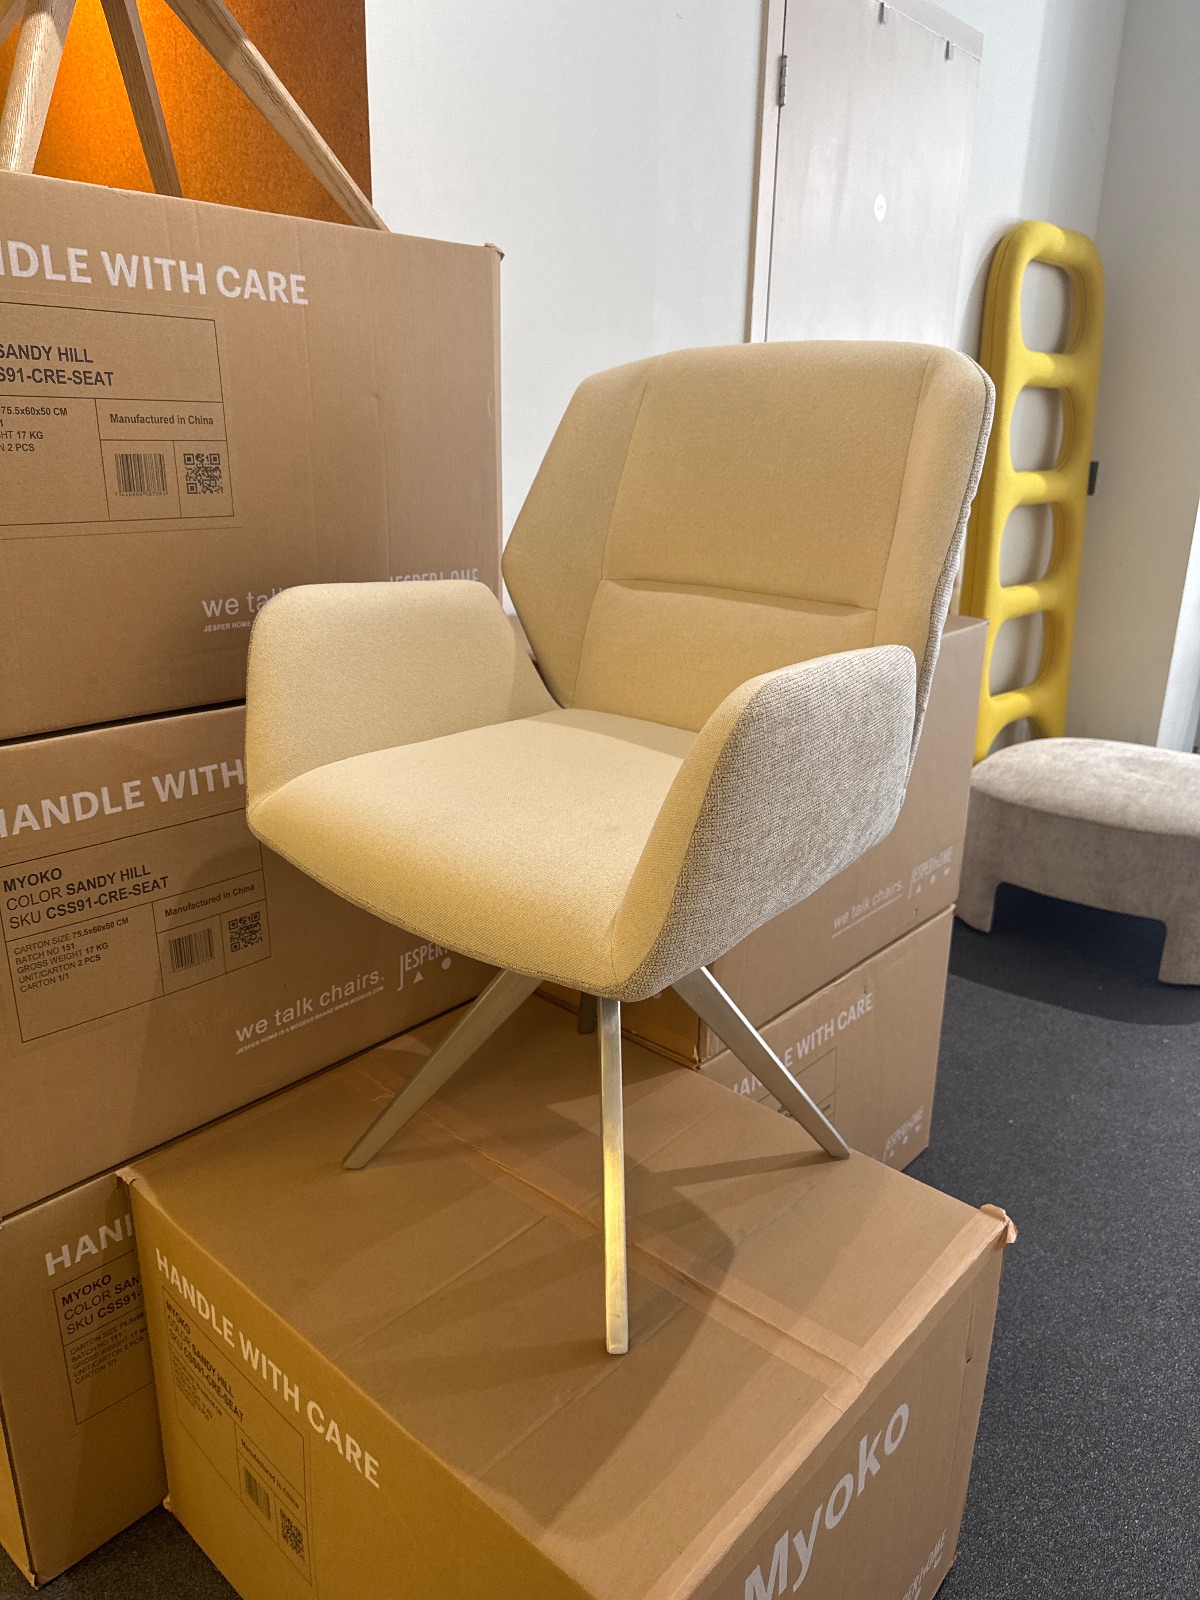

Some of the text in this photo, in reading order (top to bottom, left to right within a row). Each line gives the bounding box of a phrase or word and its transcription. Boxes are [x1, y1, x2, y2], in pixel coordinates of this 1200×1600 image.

[0, 240, 309, 305] DLE WITH CARE
[58, 347, 94, 364] HILL
[1, 406, 68, 416] 75.5x60x50 CM
[110, 413, 214, 425] Manufactured in China
[8, 444, 14, 452] 2
[16, 444, 35, 452] PCS
[17, 430, 27, 440] 17
[30, 431, 44, 440] KG
[202, 587, 285, 618] we ta
[203, 620, 252, 633] JESPER HOME
[152, 758, 245, 802] WITH
[3, 867, 63, 893] MYOKO
[6, 864, 152, 911] COLOR SANDY HILL
[9, 876, 169, 930] SKU CSS91-CRE-SEAT
[164, 884, 255, 917] Manufactured in China
[833, 911, 850, 929] we
[851, 896, 871, 919] talk
[14, 917, 129, 955] CARTON SIZE 75.5x60x50 CM
[15, 942, 75, 966] BATCH NO 151
[17, 942, 109, 974] GROSS WEIGHT 17 KG
[18, 953, 102, 984] UNIT/CARTON 2 PCS
[20, 972, 70, 993] CARTON 1/1
[235, 970, 385, 1042] we talk chairs.
[796, 1018, 835, 1060] WITH
[837, 992, 874, 1031] CARE
[61, 1274, 112, 1307] MYOKO
[64, 1290, 110, 1321] COLOR
[66, 1313, 94, 1335] SKU
[165, 1300, 191, 1335] MYOKO
[156, 1247, 235, 1348] HANDLE
[239, 1331, 300, 1413] WITH
[307, 1400, 380, 1490] CARE
[191, 1343, 216, 1376] SANDY
[217, 1372, 234, 1399] HILL
[744, 1402, 909, 1600] Myoko
